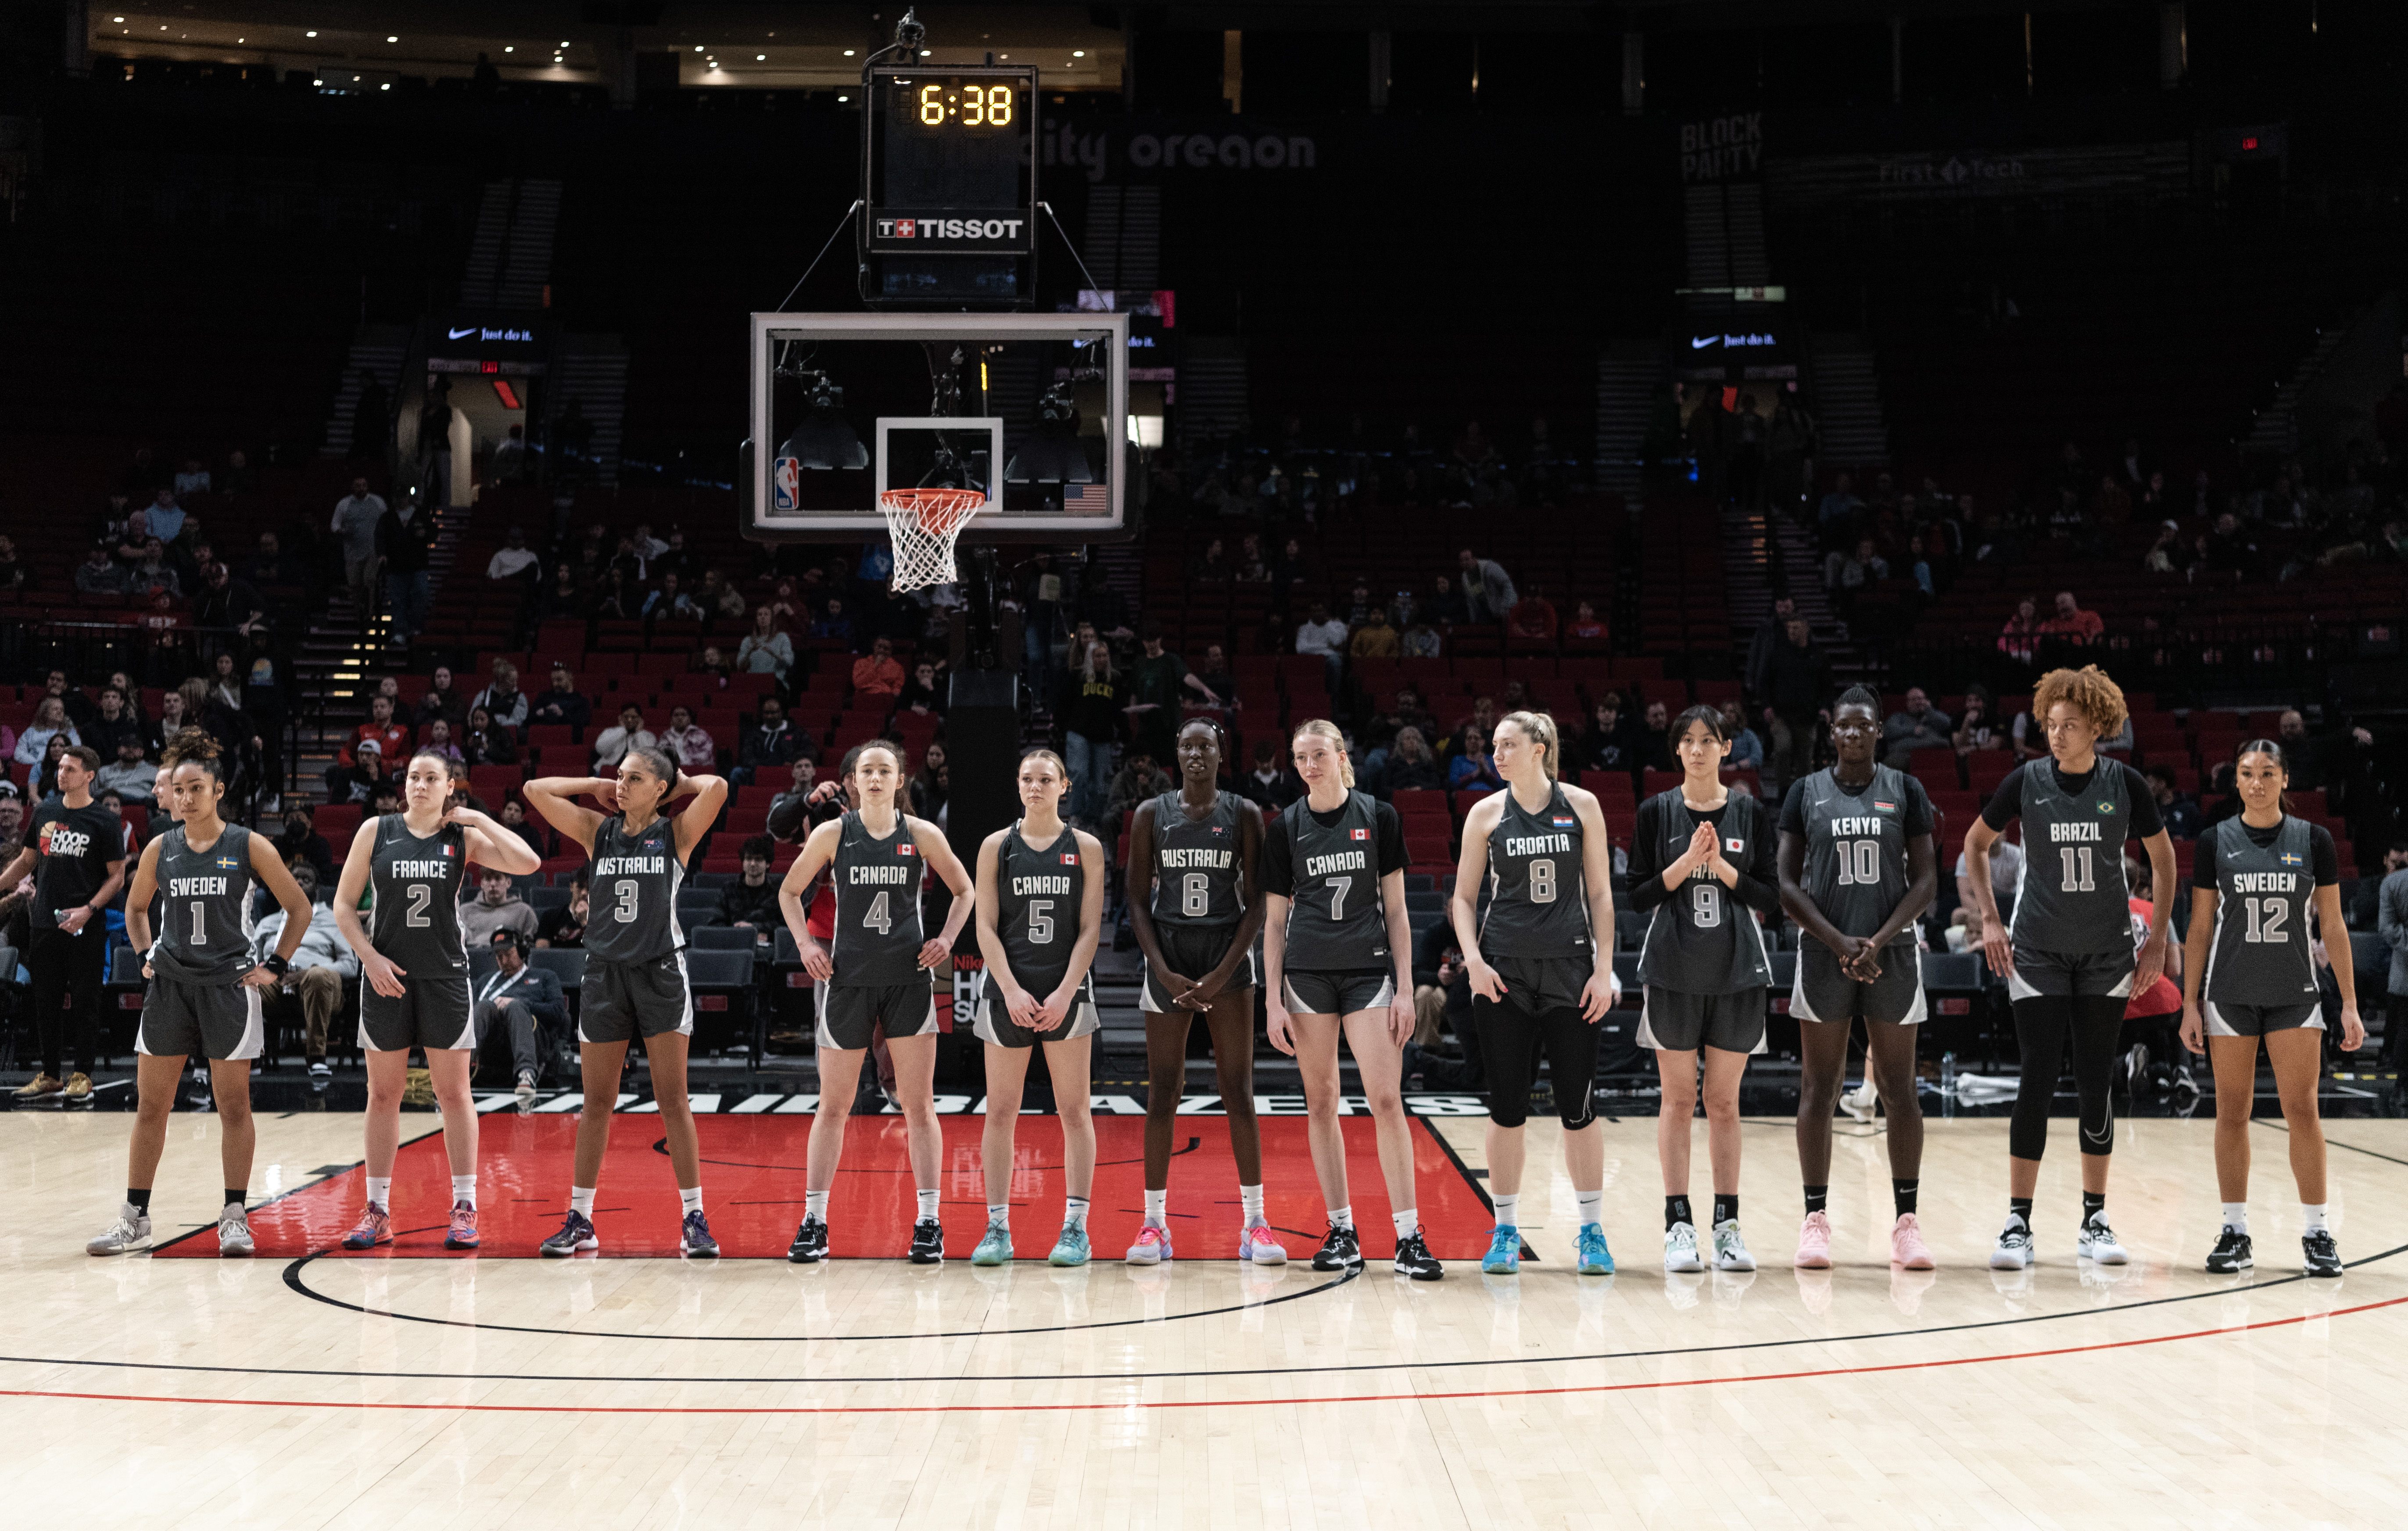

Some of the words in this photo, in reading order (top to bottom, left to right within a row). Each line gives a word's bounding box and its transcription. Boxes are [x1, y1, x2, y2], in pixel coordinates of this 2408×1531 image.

[921, 85, 1012, 125] 6:38
[1681, 111, 1762, 153] BLOCK
[1972, 159, 2024, 178] Tech
[917, 219, 1023, 239] TISSOT
[481, 327, 502, 341] Just
[504, 329, 521, 341] do
[521, 330, 533, 341] it.
[1746, 333, 1763, 346] do
[51, 829, 90, 847] HOOP
[1831, 816, 1881, 837] KENYA
[2050, 822, 2102, 842] BRAZIL
[1506, 833, 1570, 857] CROATIA
[392, 860, 447, 879] FRANCE
[596, 856, 664, 876] AUSTRALIA
[1161, 849, 1232, 868] AUSTRALIA
[1306, 851, 1365, 876] CANADA
[1836, 839, 1880, 886] 10
[2060, 846, 2096, 892] 11
[169, 876, 227, 897] SWEDEN
[850, 866, 907, 885] CANADA
[1012, 876, 1070, 896] CANADA
[1529, 858, 1557, 904] 8
[2233, 872, 2297, 893] SWEDEN
[406, 884, 431, 928] 2
[614, 879, 639, 923] 3
[1182, 872, 1209, 917] 6
[1325, 876, 1352, 921] 7
[1693, 884, 1721, 928] 9
[190, 901, 207, 945] 1
[863, 891, 892, 935] 4
[1028, 900, 1054, 944] 5
[2245, 897, 2289, 943] 12
